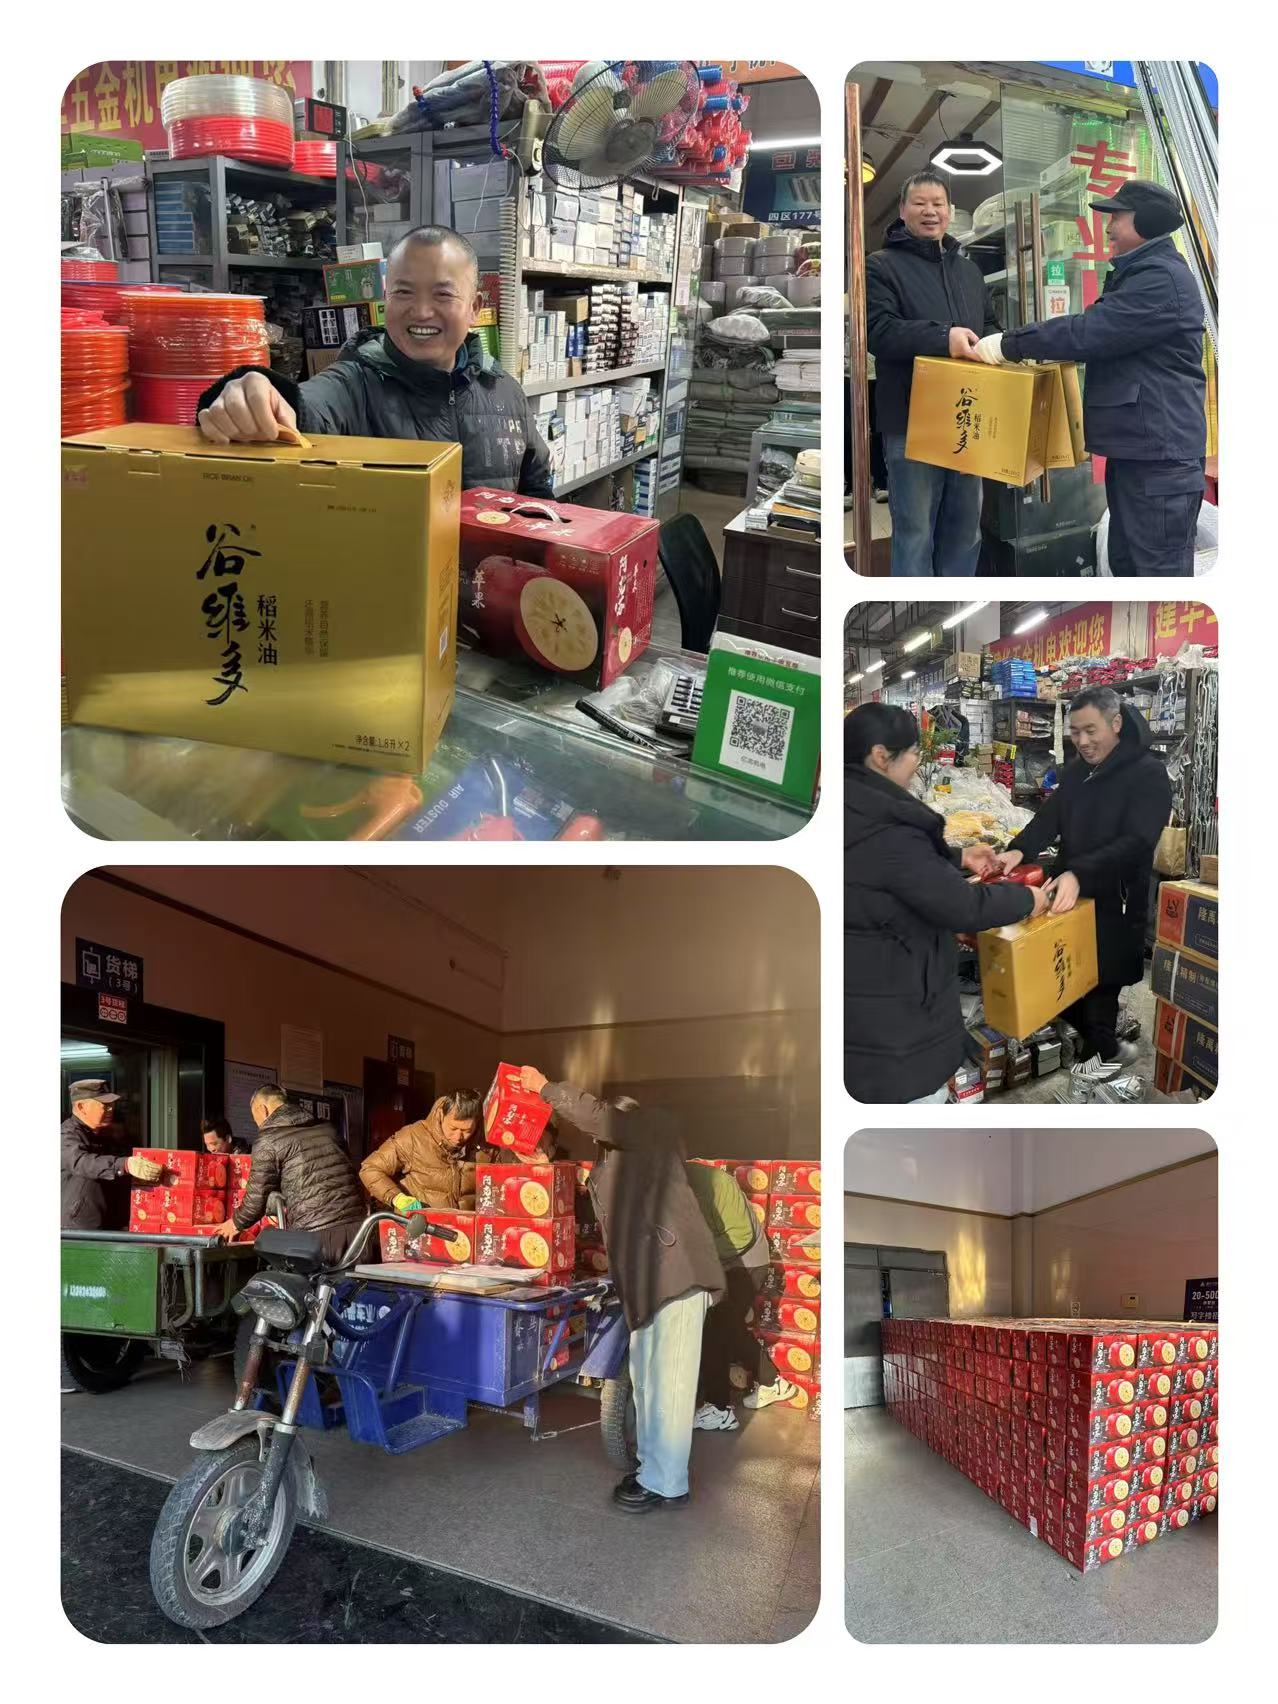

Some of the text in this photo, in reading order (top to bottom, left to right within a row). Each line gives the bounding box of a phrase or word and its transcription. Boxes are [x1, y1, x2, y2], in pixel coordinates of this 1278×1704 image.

[952, 387, 978, 454] 谷维多
[472, 568, 487, 610] 苹果
[196, 522, 262, 706] 谷维多
[256, 594, 278, 666] 稻米油
[727, 667, 806, 696] 推荐使用微信支付
[447, 783, 465, 799] AIR
[412, 799, 449, 833] DUSTER
[105, 954, 138, 980] 货梯
